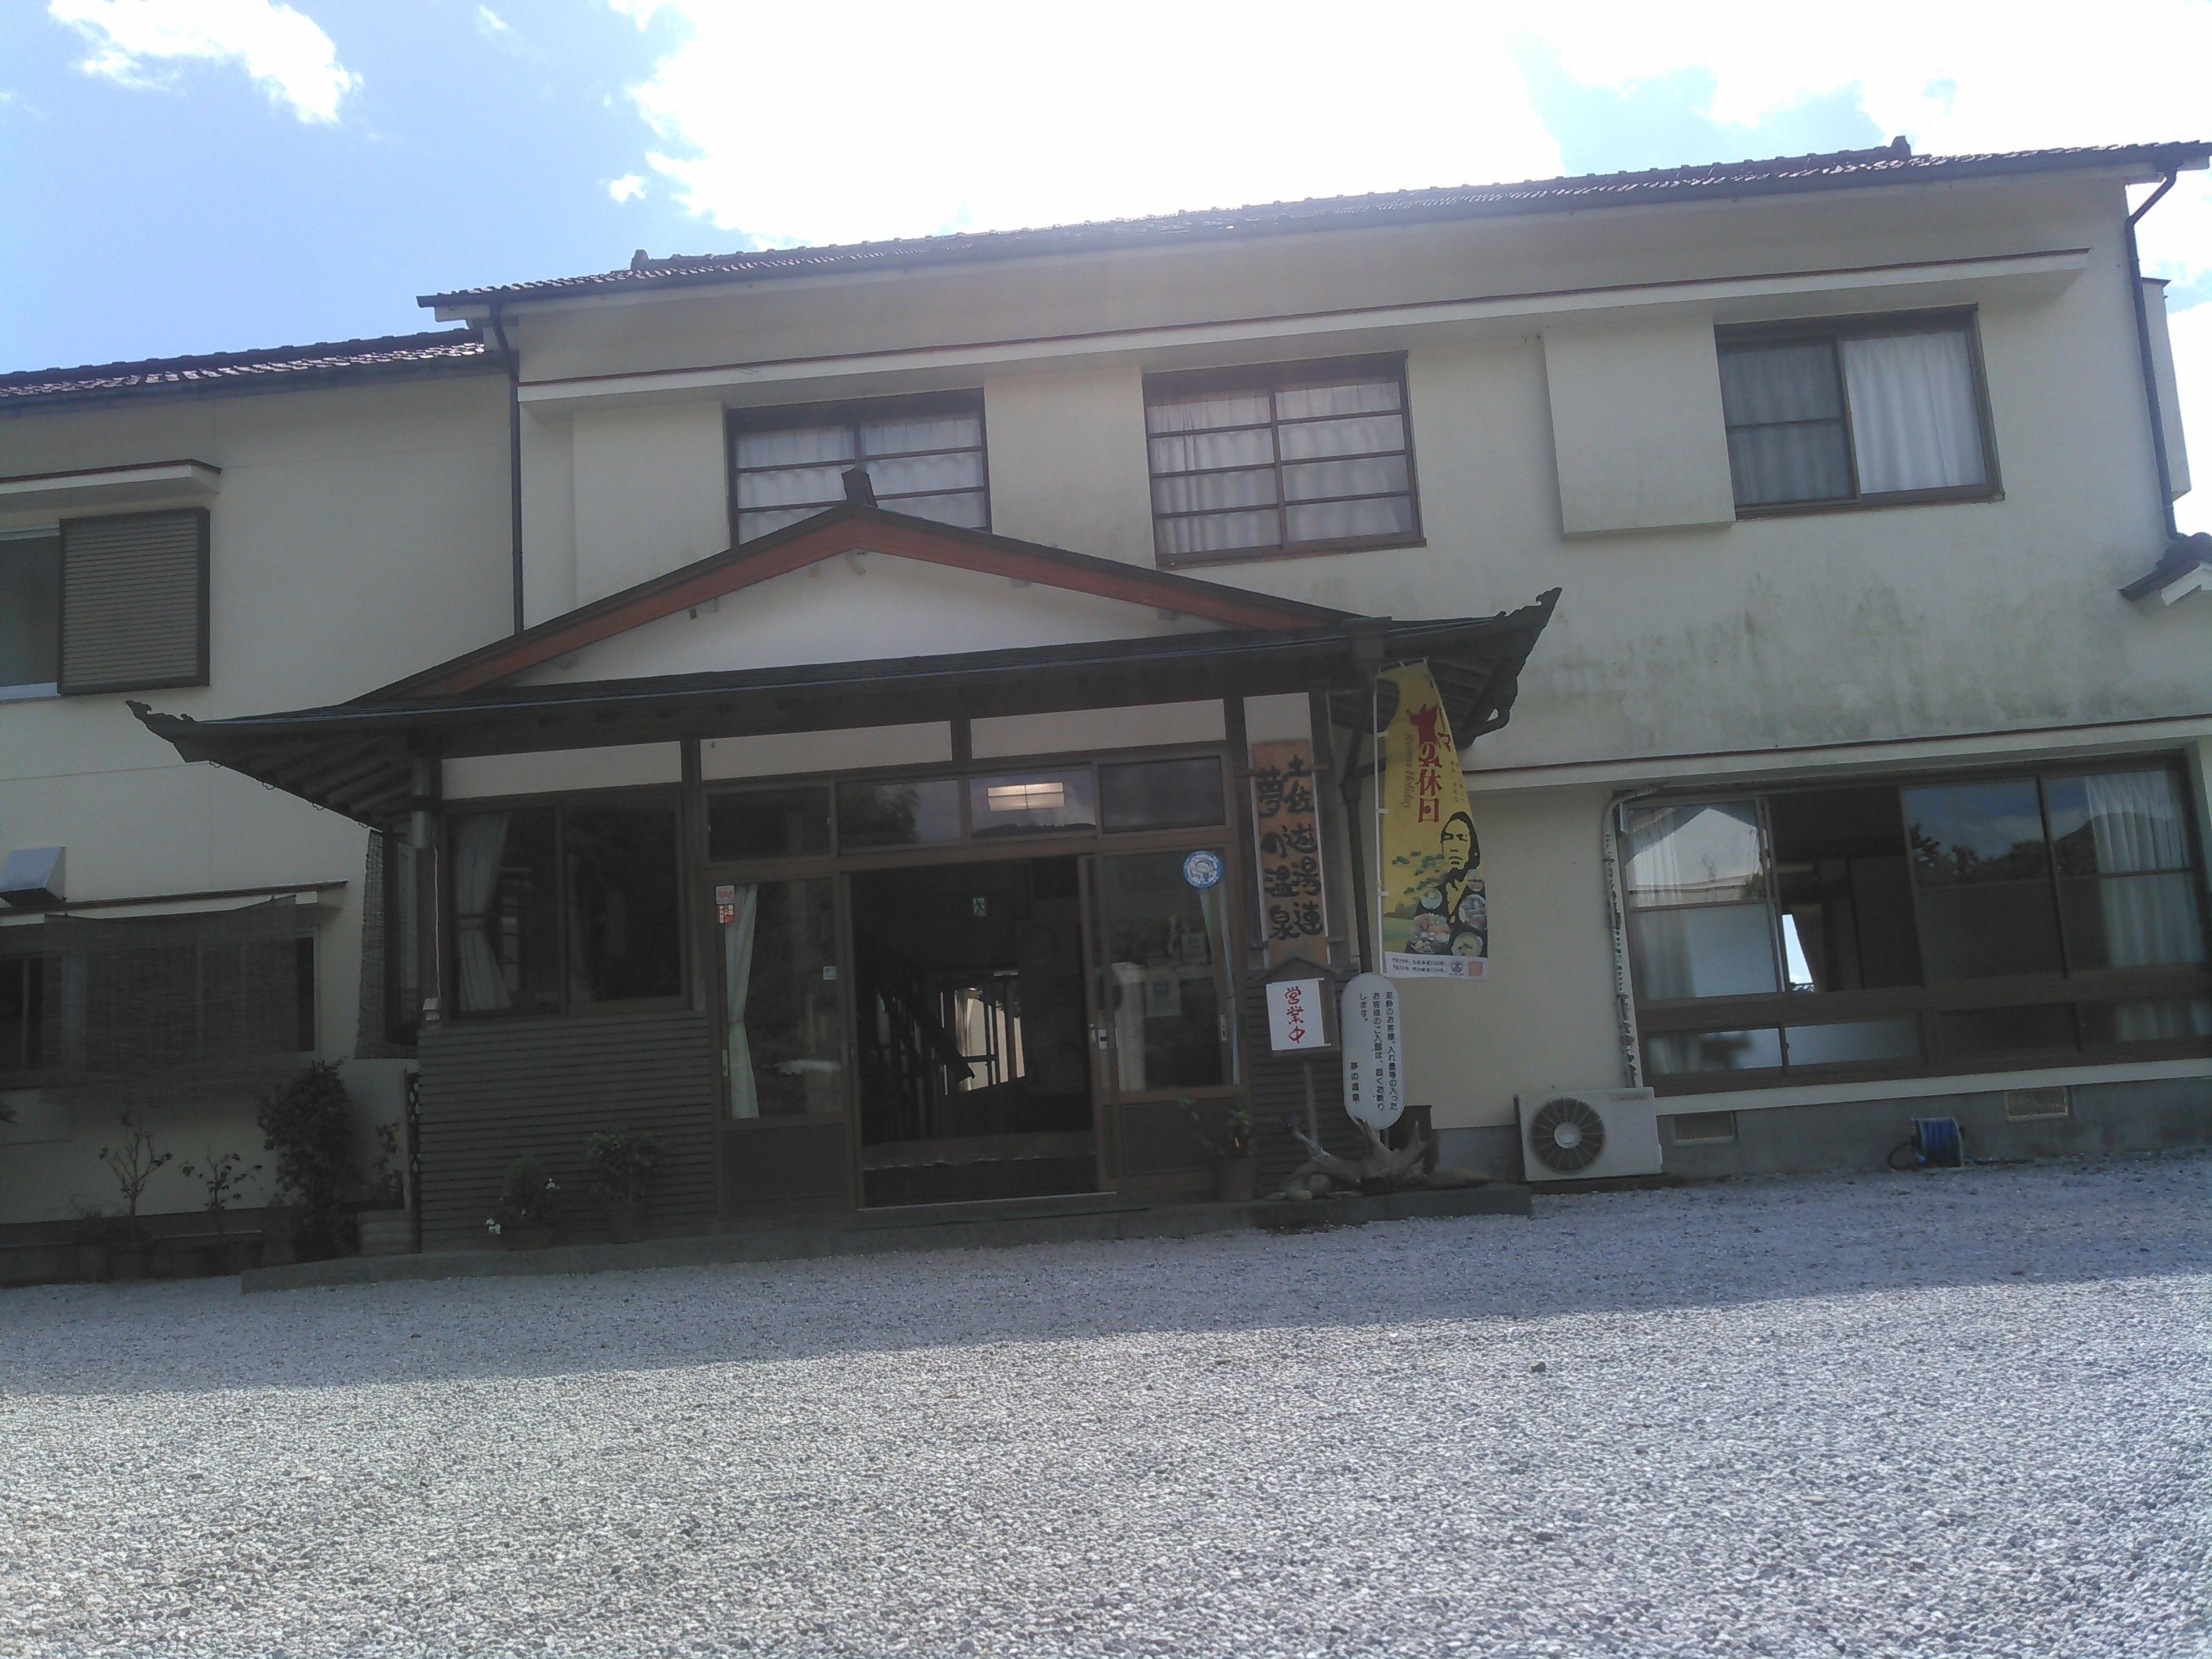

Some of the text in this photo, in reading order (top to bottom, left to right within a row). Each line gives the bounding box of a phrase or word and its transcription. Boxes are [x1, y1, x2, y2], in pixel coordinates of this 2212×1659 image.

[1401, 770, 1415, 809] Holiday
[1416, 741, 1443, 823] の休日
[1256, 766, 1299, 940] 夢の温泉
[1284, 986, 1305, 1044] 営業中
[1360, 992, 1368, 1021] します。
[1351, 1062, 1360, 1102] 夢の温泉
